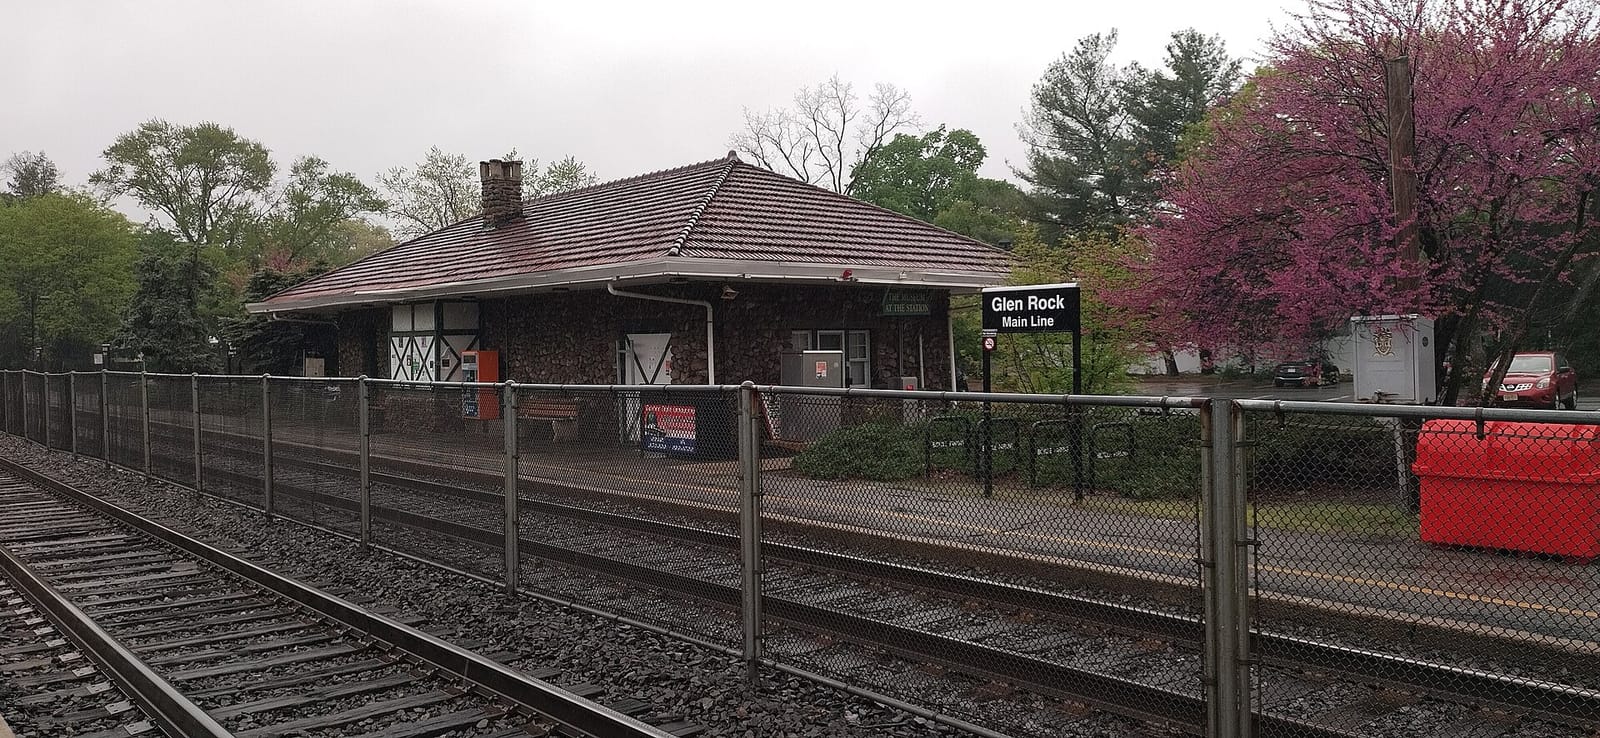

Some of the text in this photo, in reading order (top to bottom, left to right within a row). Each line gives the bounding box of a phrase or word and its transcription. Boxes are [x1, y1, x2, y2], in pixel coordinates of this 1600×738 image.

[886, 303, 929, 312] AT THE STATION
[991, 295, 1065, 312] Glen Rock
[1002, 315, 1054, 327] Main Line
